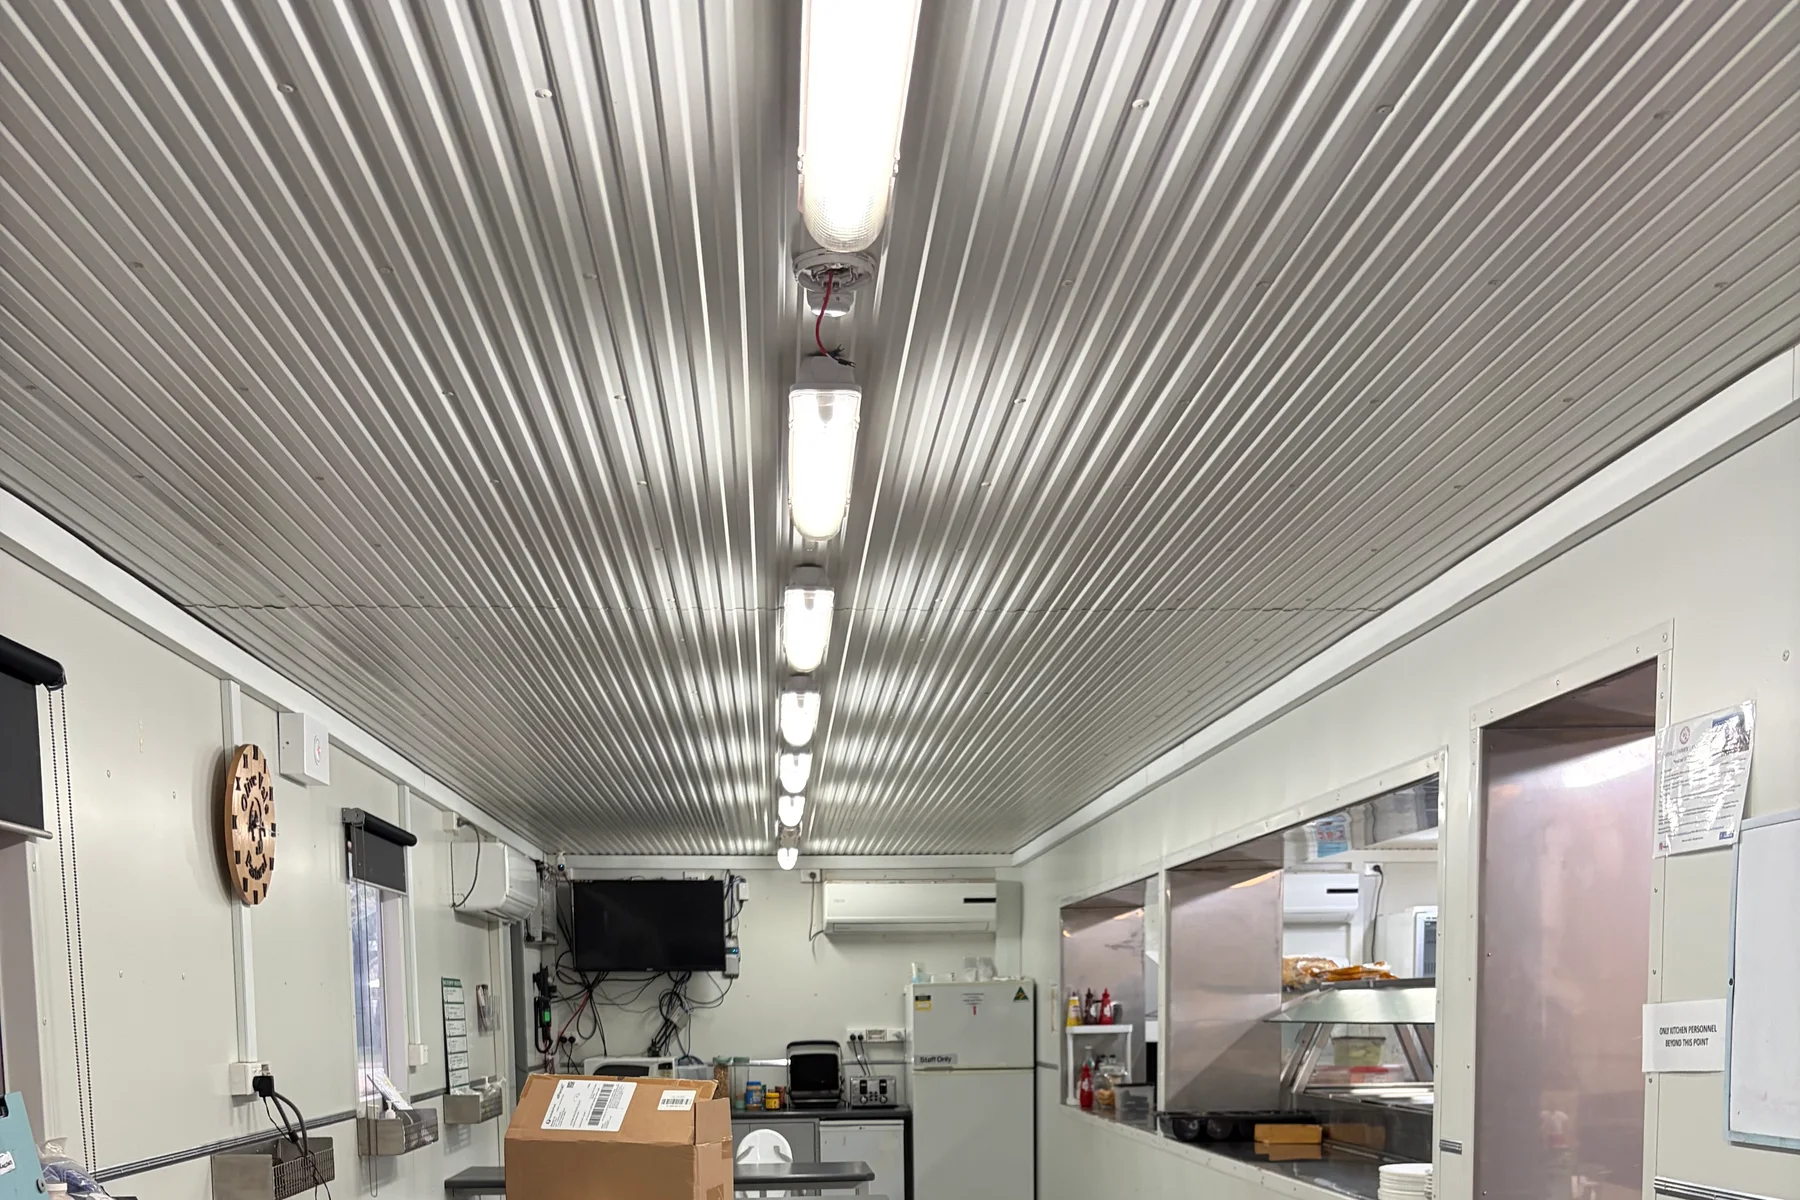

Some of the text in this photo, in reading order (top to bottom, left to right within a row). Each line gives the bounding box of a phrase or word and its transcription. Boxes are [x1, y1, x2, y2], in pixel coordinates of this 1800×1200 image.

[235, 776, 242, 791] X
[241, 771, 270, 815] Olive Vale
[1659, 1023, 1718, 1035] ONLY KITCHEN PERSONNEL
[1664, 1037, 1709, 1048] BEYOND THIS POINT
[919, 1055, 952, 1065] Staff Only
